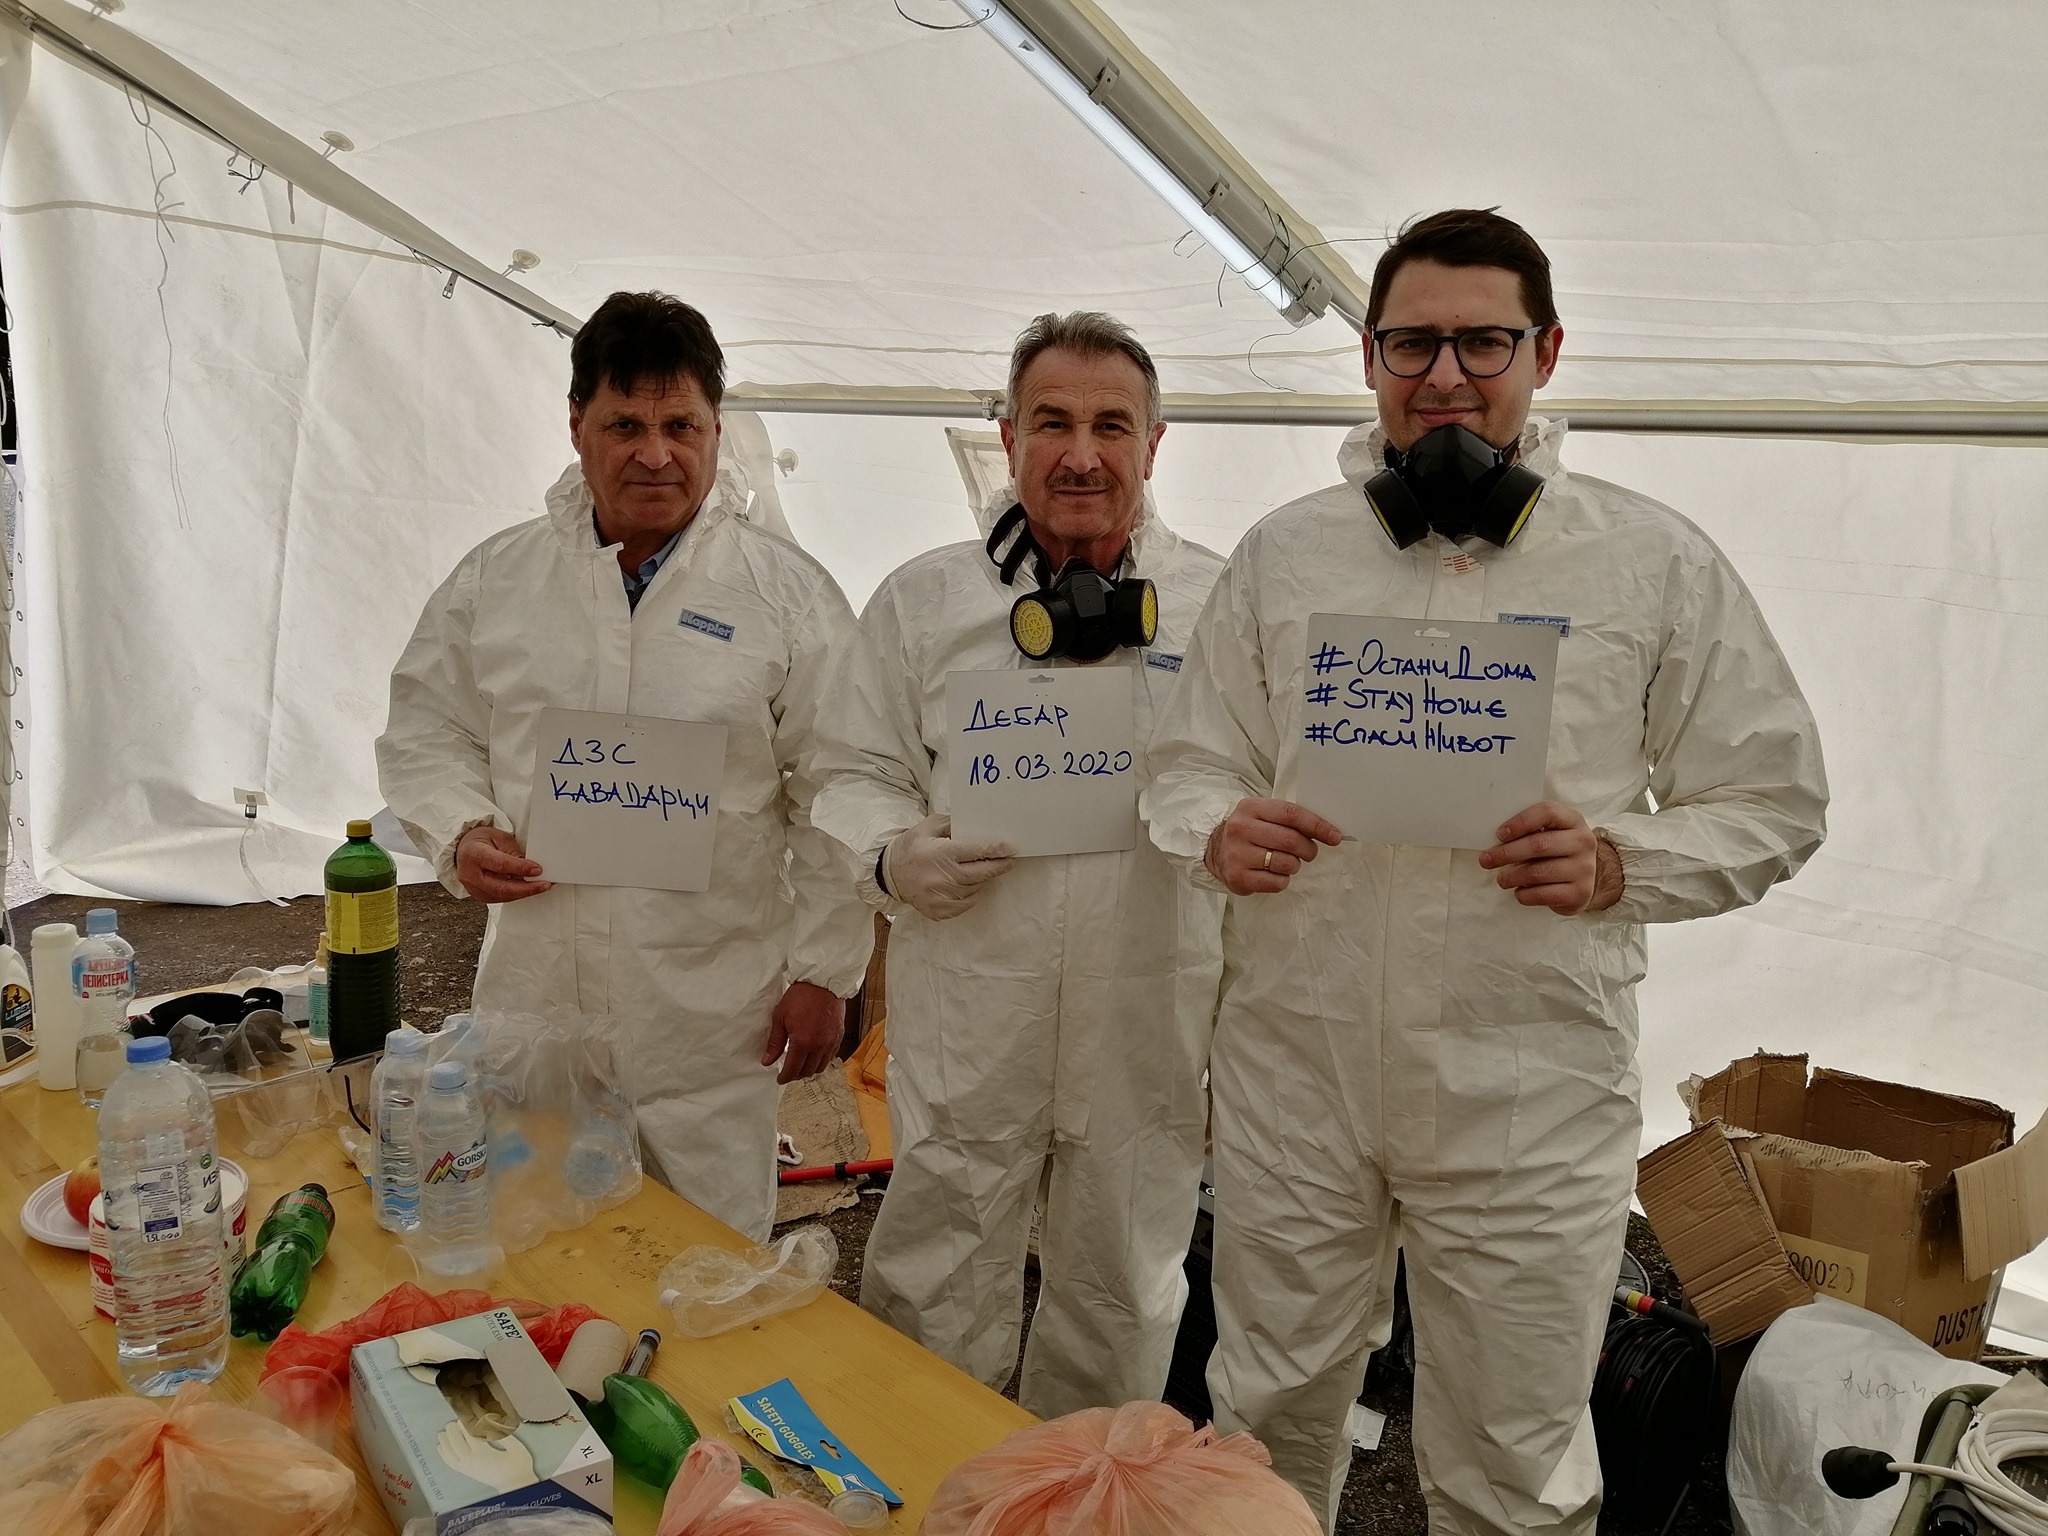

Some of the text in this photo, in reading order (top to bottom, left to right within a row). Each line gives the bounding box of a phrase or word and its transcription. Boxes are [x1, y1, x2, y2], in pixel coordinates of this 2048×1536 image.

[962, 698, 1069, 738] ДЕБАР
[551, 737, 636, 766] ДЗС
[969, 750, 1133, 787] 18.03.2020
[82, 970, 130, 989] ПЕЛИСТЕРКА
[1933, 1305, 1979, 1348] DUST
[756, 1396, 816, 1461] SAFETY GOGGLES
[580, 1445, 595, 1459] XL
[585, 1472, 603, 1487] XL
[529, 1492, 562, 1509] GLOVES
